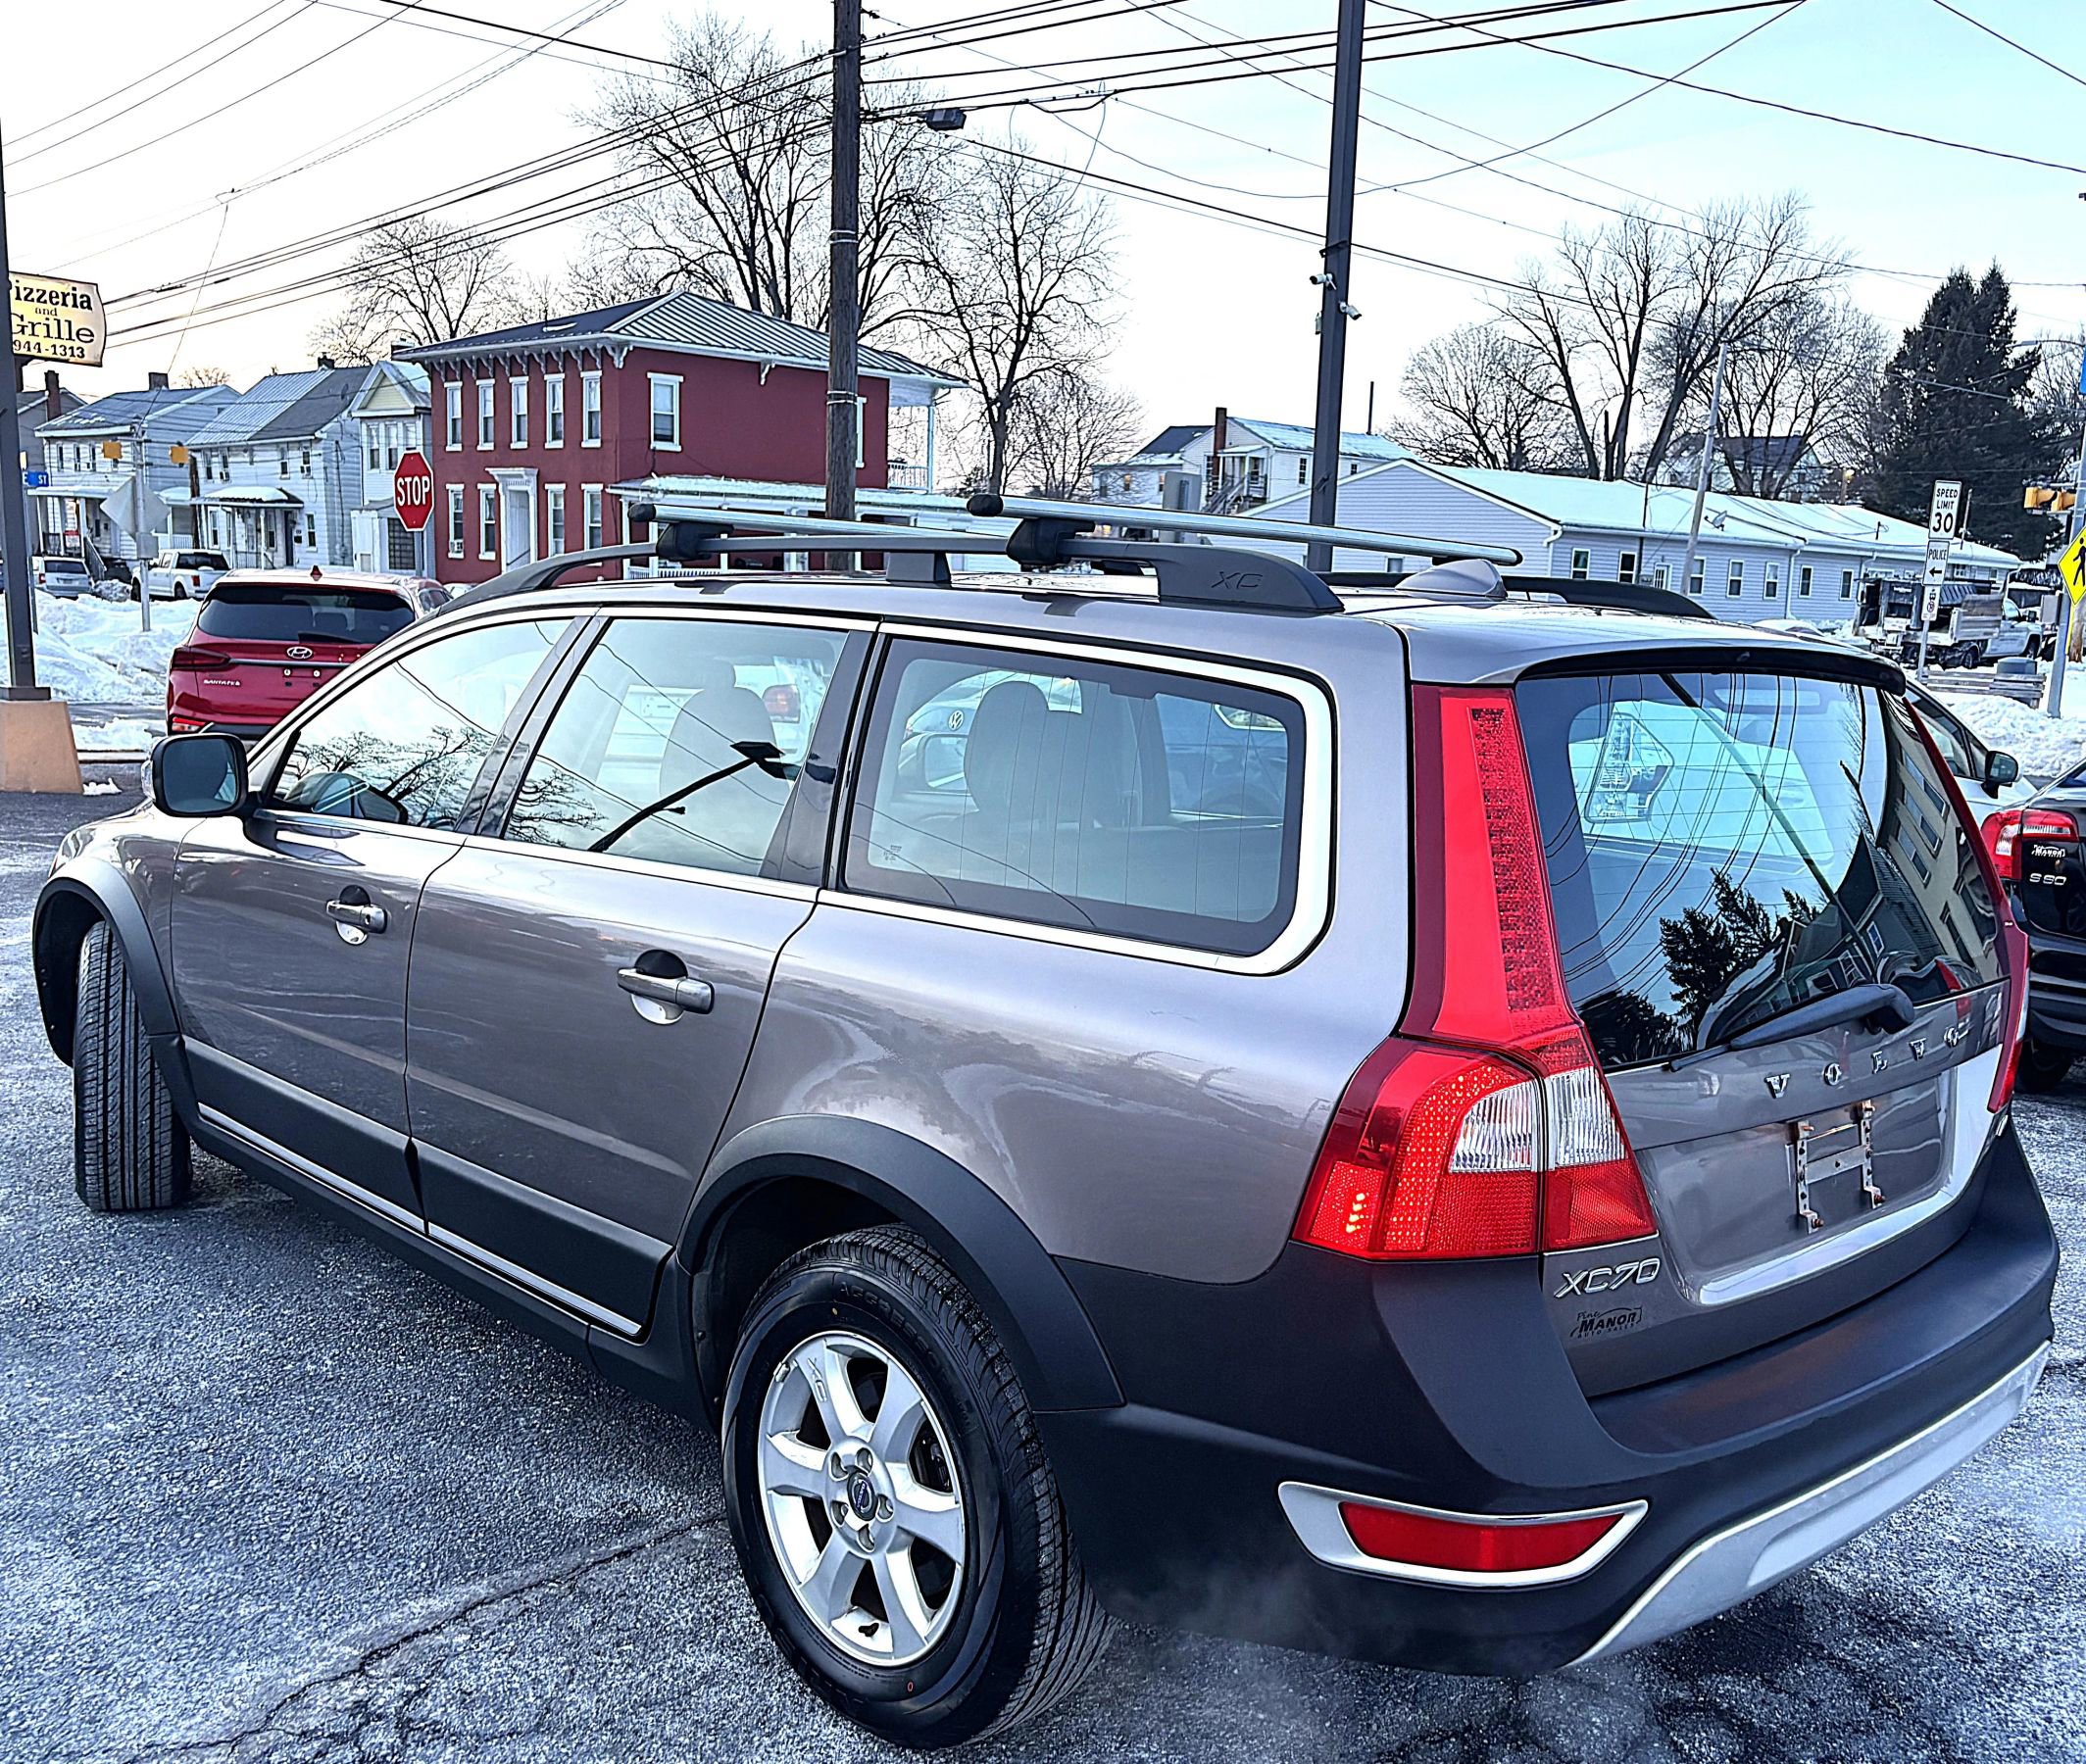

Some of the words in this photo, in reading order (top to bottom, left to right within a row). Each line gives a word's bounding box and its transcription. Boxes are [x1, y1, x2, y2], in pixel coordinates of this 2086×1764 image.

[11, 279, 93, 312] izzeria
[35, 307, 58, 317] and
[11, 313, 95, 344] Grille
[13, 339, 85, 359] 944-1313
[38, 474, 48, 485] ST
[396, 475, 430, 507] STOP
[1936, 487, 1959, 499] SPEED
[1936, 500, 1955, 510] LIMIT
[1932, 512, 1955, 533] 30
[1928, 548, 1948, 562] POLICE
[1211, 570, 1264, 590] XC
[1553, 1256, 1661, 1298] XC70
[1578, 1311, 1637, 1334] MANOR
